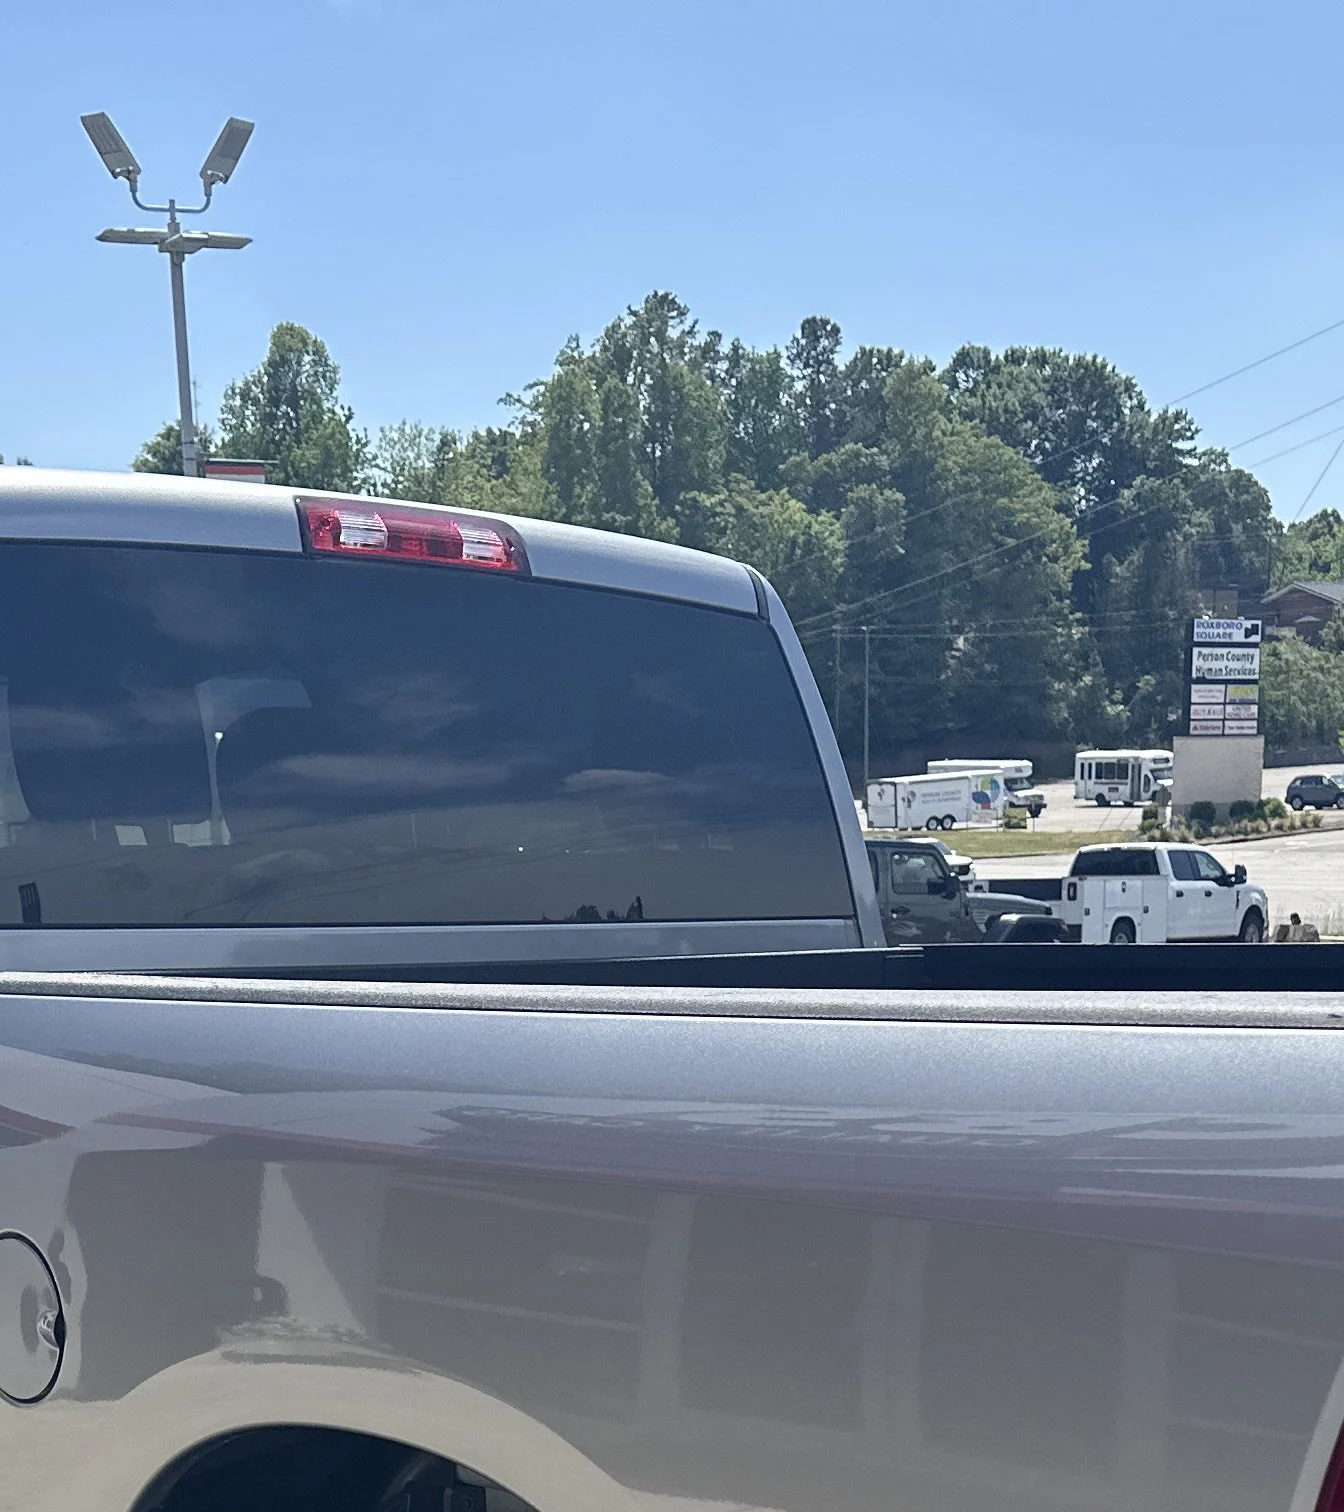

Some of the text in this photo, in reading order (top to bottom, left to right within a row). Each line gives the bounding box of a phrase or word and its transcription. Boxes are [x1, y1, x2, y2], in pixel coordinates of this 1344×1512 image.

[1196, 621, 1243, 631] ROXBORO
[1196, 631, 1234, 640] SQUARE
[1197, 650, 1255, 665] Person County
